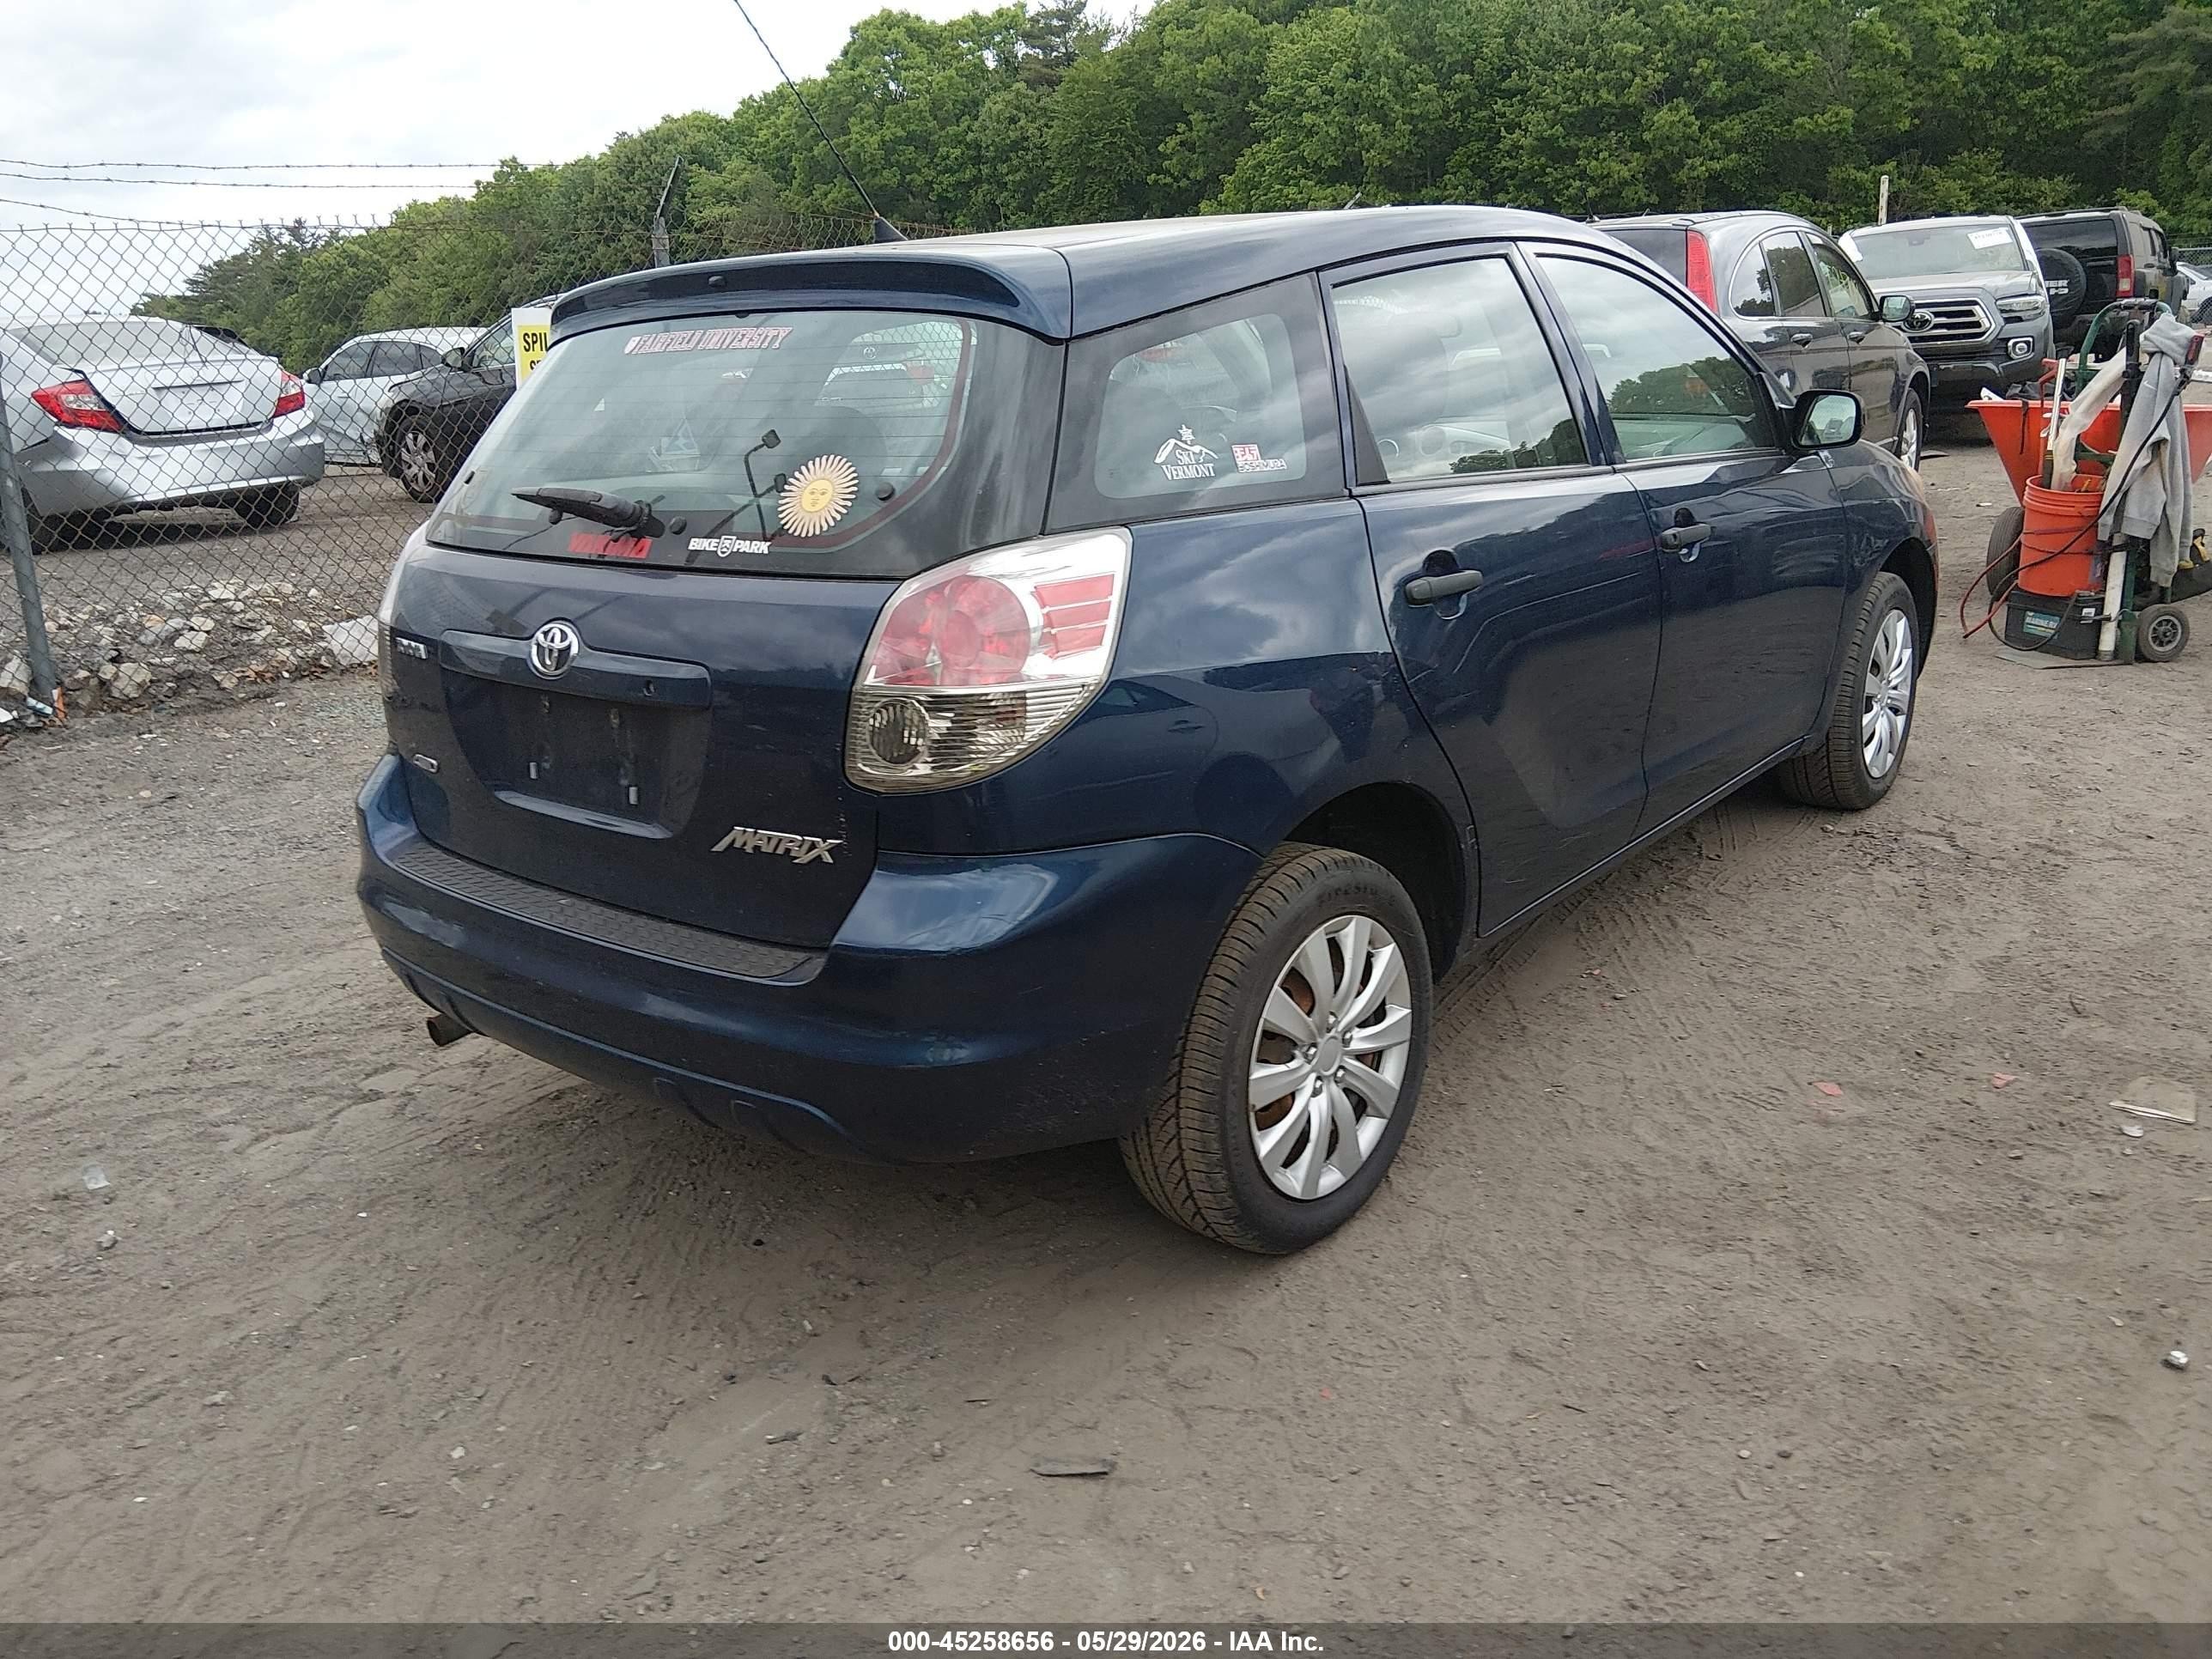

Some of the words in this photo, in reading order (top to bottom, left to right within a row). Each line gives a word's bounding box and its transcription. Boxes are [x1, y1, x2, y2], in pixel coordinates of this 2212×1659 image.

[632, 330, 704, 355] FAIRFIELD
[697, 326, 793, 350] UNIVERSITY
[1175, 449, 1195, 465] SKI
[1161, 463, 1216, 481] VERMONT
[688, 538, 720, 551] BIKE
[732, 538, 773, 555] PARK
[710, 825, 844, 864] MATRIX
